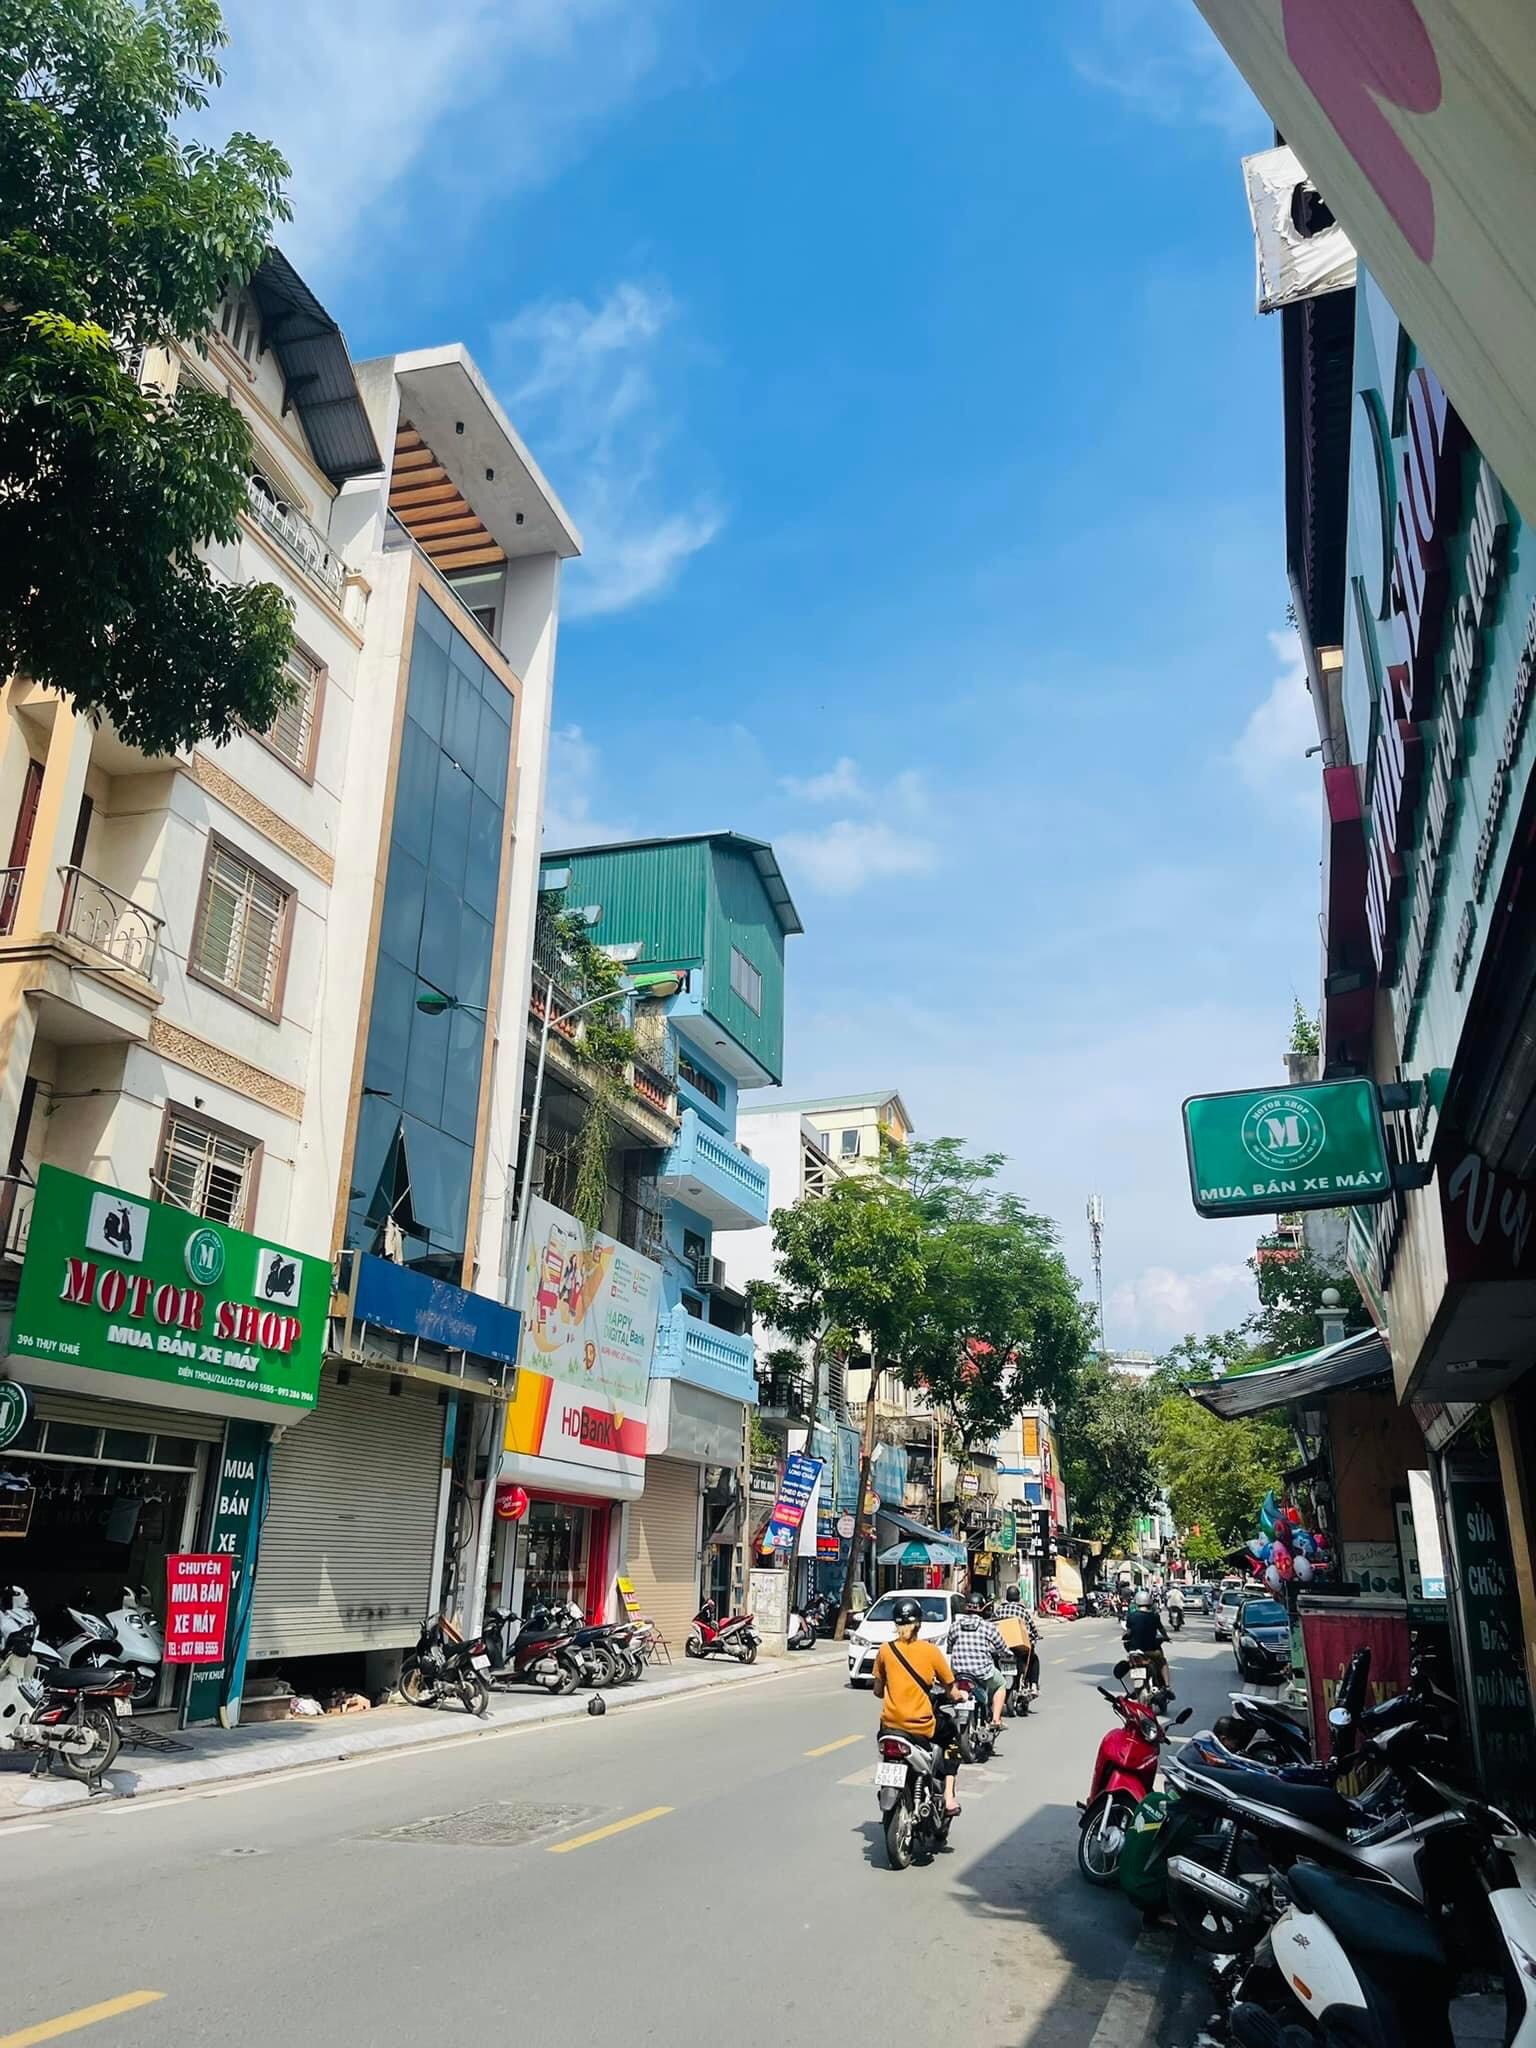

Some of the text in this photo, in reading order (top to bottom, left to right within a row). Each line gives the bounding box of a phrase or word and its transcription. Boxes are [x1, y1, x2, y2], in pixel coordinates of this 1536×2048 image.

[1439, 674, 1457, 780] CŨ
[1449, 594, 1474, 718] CÁC
[1465, 456, 1496, 628] LOẠI
[1251, 1099, 1310, 1121] MOTOR SHOP
[1264, 1115, 1303, 1149] M
[1200, 1170, 1384, 1201] MUA BÁN XE MÁY
[199, 1243, 215, 1269] M
[59, 1256, 302, 1354] MOTOR SHOP
[605, 1309, 633, 1333] HAPPY
[17, 1333, 34, 1348] 396
[107, 1324, 261, 1371] MUA BÁN XE MÁY
[602, 1325, 645, 1347] DIGITAL Bank
[561, 1403, 613, 1446] HDBank
[224, 1459, 255, 1480] MUA
[219, 1490, 249, 1516] BÁN
[217, 1533, 236, 1553] XE
[178, 1559, 221, 1576] CHUYÊN
[171, 1583, 198, 1602] MUA
[200, 1579, 224, 1603] BÁN
[174, 1610, 217, 1635] XE MÁY
